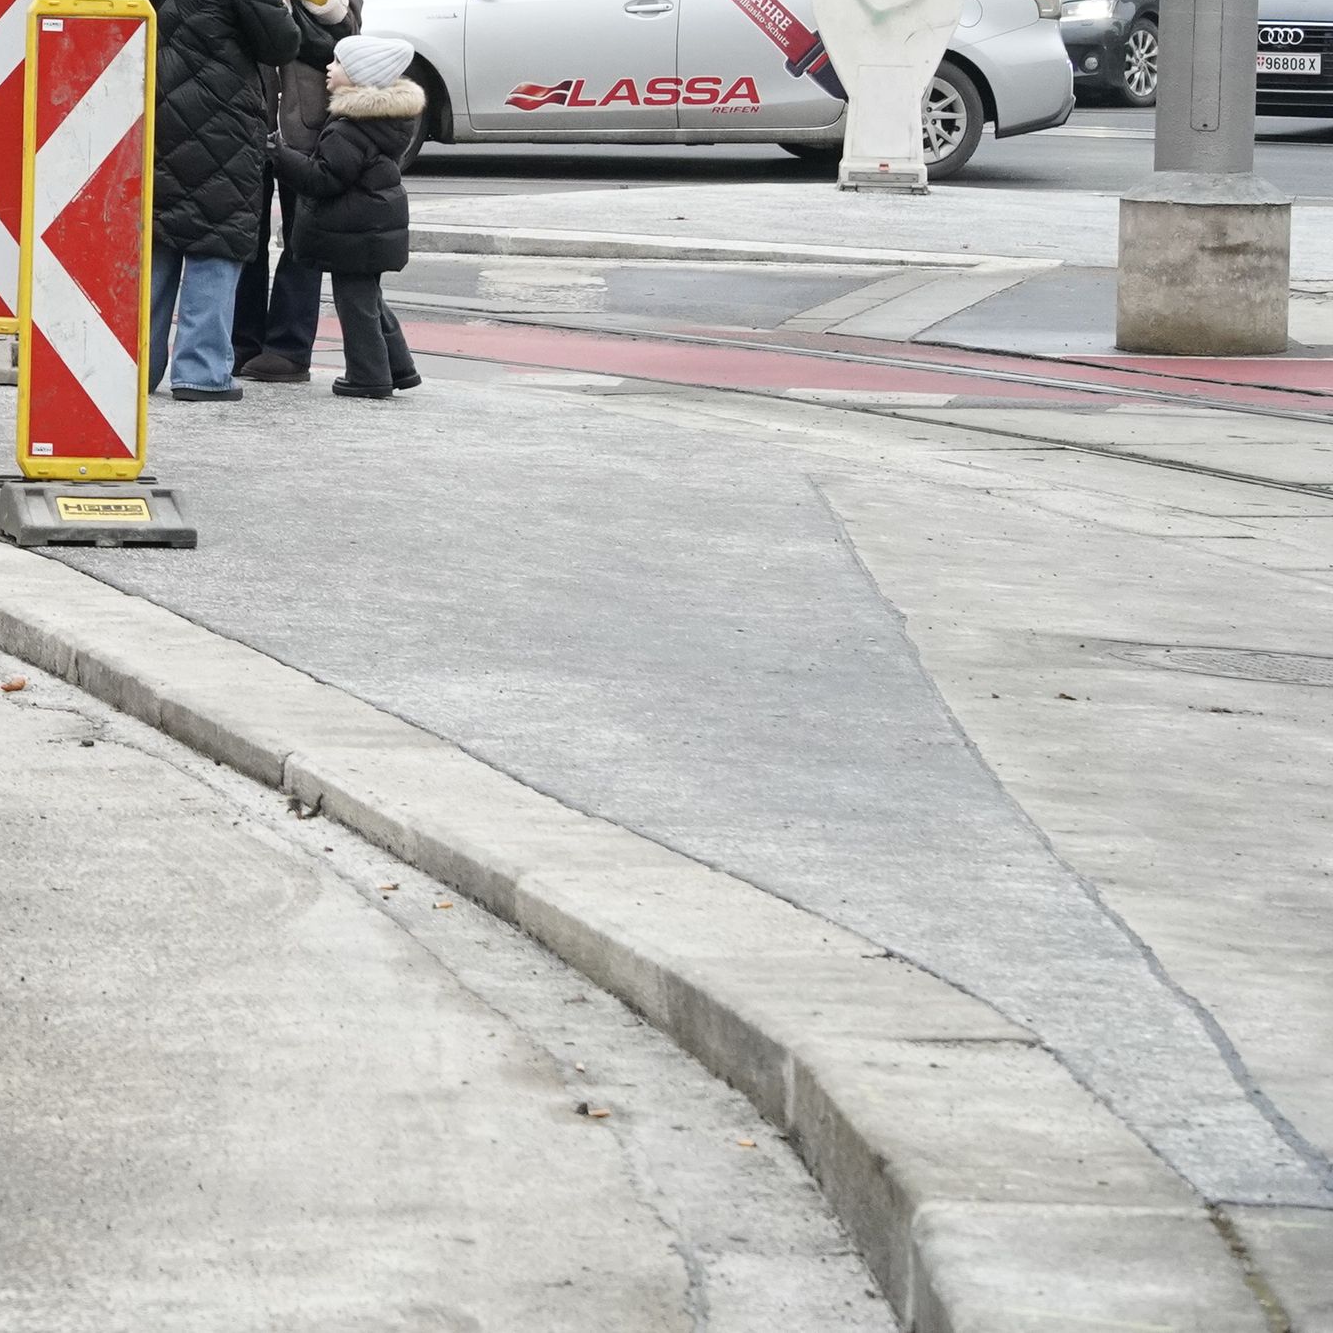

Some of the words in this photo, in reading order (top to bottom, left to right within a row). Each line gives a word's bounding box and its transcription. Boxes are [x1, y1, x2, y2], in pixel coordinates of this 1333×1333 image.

[1265, 56, 1306, 71] 96808
[1308, 58, 1316, 71] X
[565, 76, 761, 108] LASSA
[710, 105, 761, 114] REIFEN
